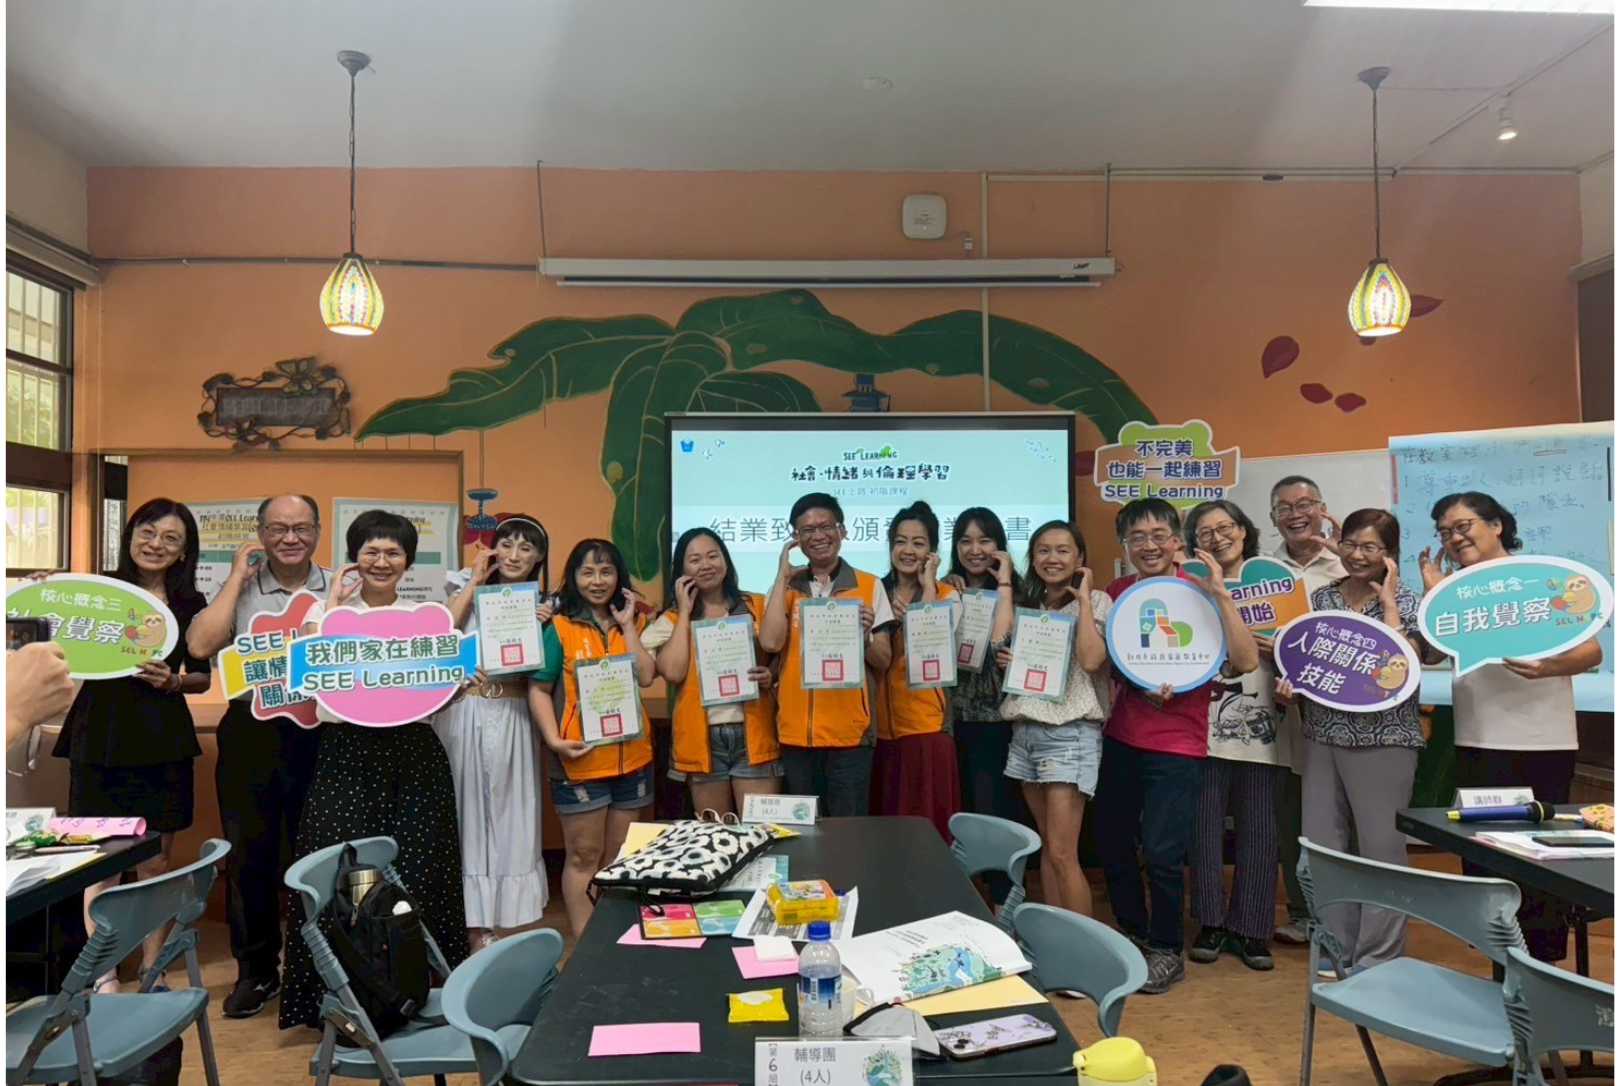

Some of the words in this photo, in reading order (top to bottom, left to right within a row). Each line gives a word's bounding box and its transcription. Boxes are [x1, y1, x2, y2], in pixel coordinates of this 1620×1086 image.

[860, 451, 898, 461] LEARNNG
[1136, 439, 1193, 457] 不完美
[1108, 460, 1221, 478] 也能一起練習
[1105, 484, 1140, 497] SEE
[1147, 484, 1223, 498] Learning
[40, 588, 122, 612] 核心概念三
[1231, 578, 1292, 600] arning
[1456, 577, 1539, 600] 核心概念一
[1435, 597, 1551, 637] 自我覺察
[237, 630, 283, 654] SEE
[1315, 621, 1377, 650] 核心概念四
[306, 635, 460, 665] 我們家在練習
[1287, 631, 1381, 675] 人際關係
[303, 671, 354, 692] SEE
[363, 665, 464, 688] Learning
[1296, 663, 1347, 695] 技能
[794, 1047, 836, 1062] 輔導團
[800, 1069, 831, 1085] (4人)
